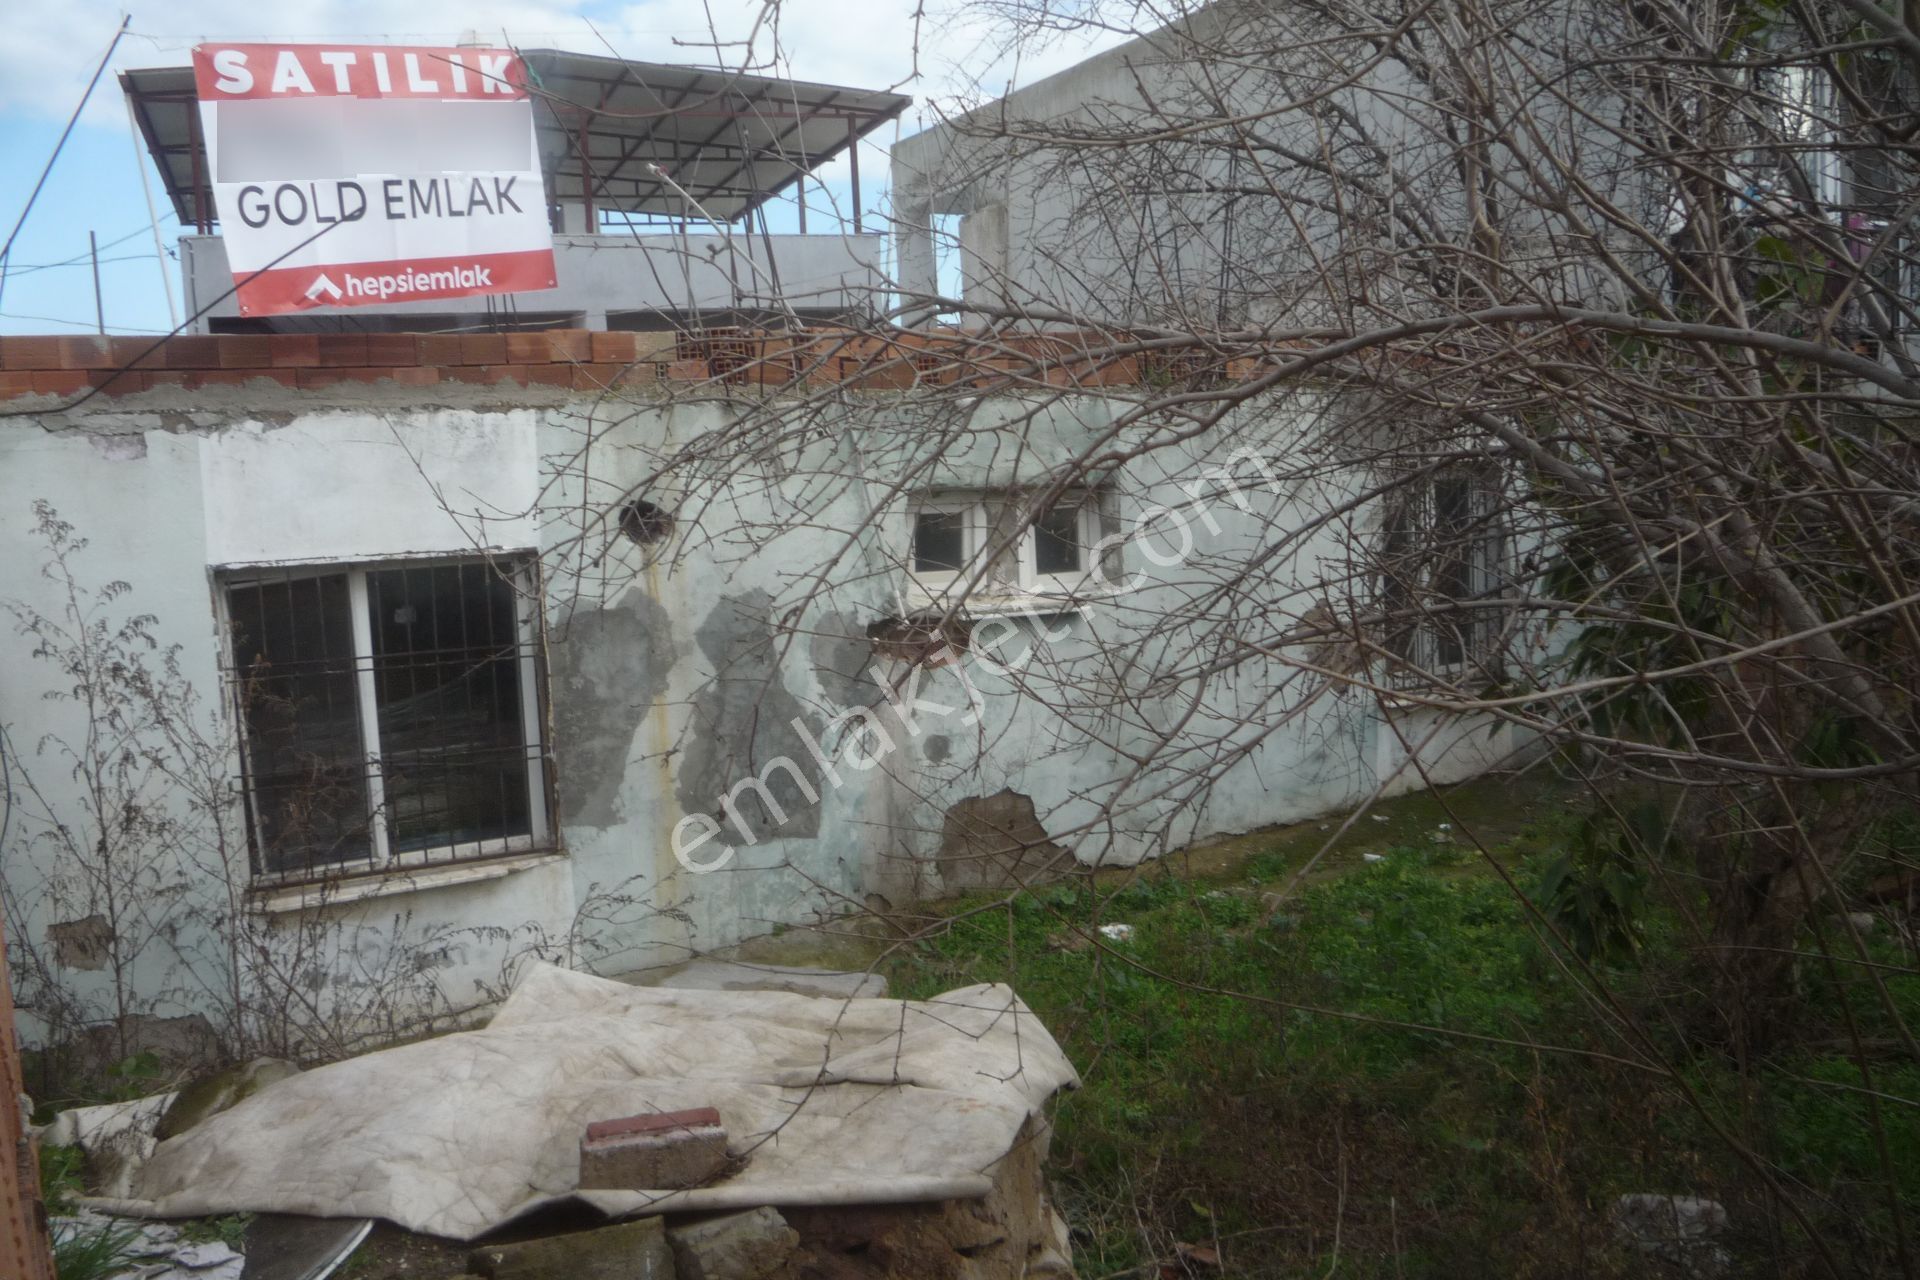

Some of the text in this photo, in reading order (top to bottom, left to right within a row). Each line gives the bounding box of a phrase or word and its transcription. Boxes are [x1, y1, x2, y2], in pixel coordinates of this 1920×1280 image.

[213, 51, 515, 94] SATILIK
[238, 176, 523, 228] GOLD EMLAK
[345, 265, 492, 298] hepsiemlak
